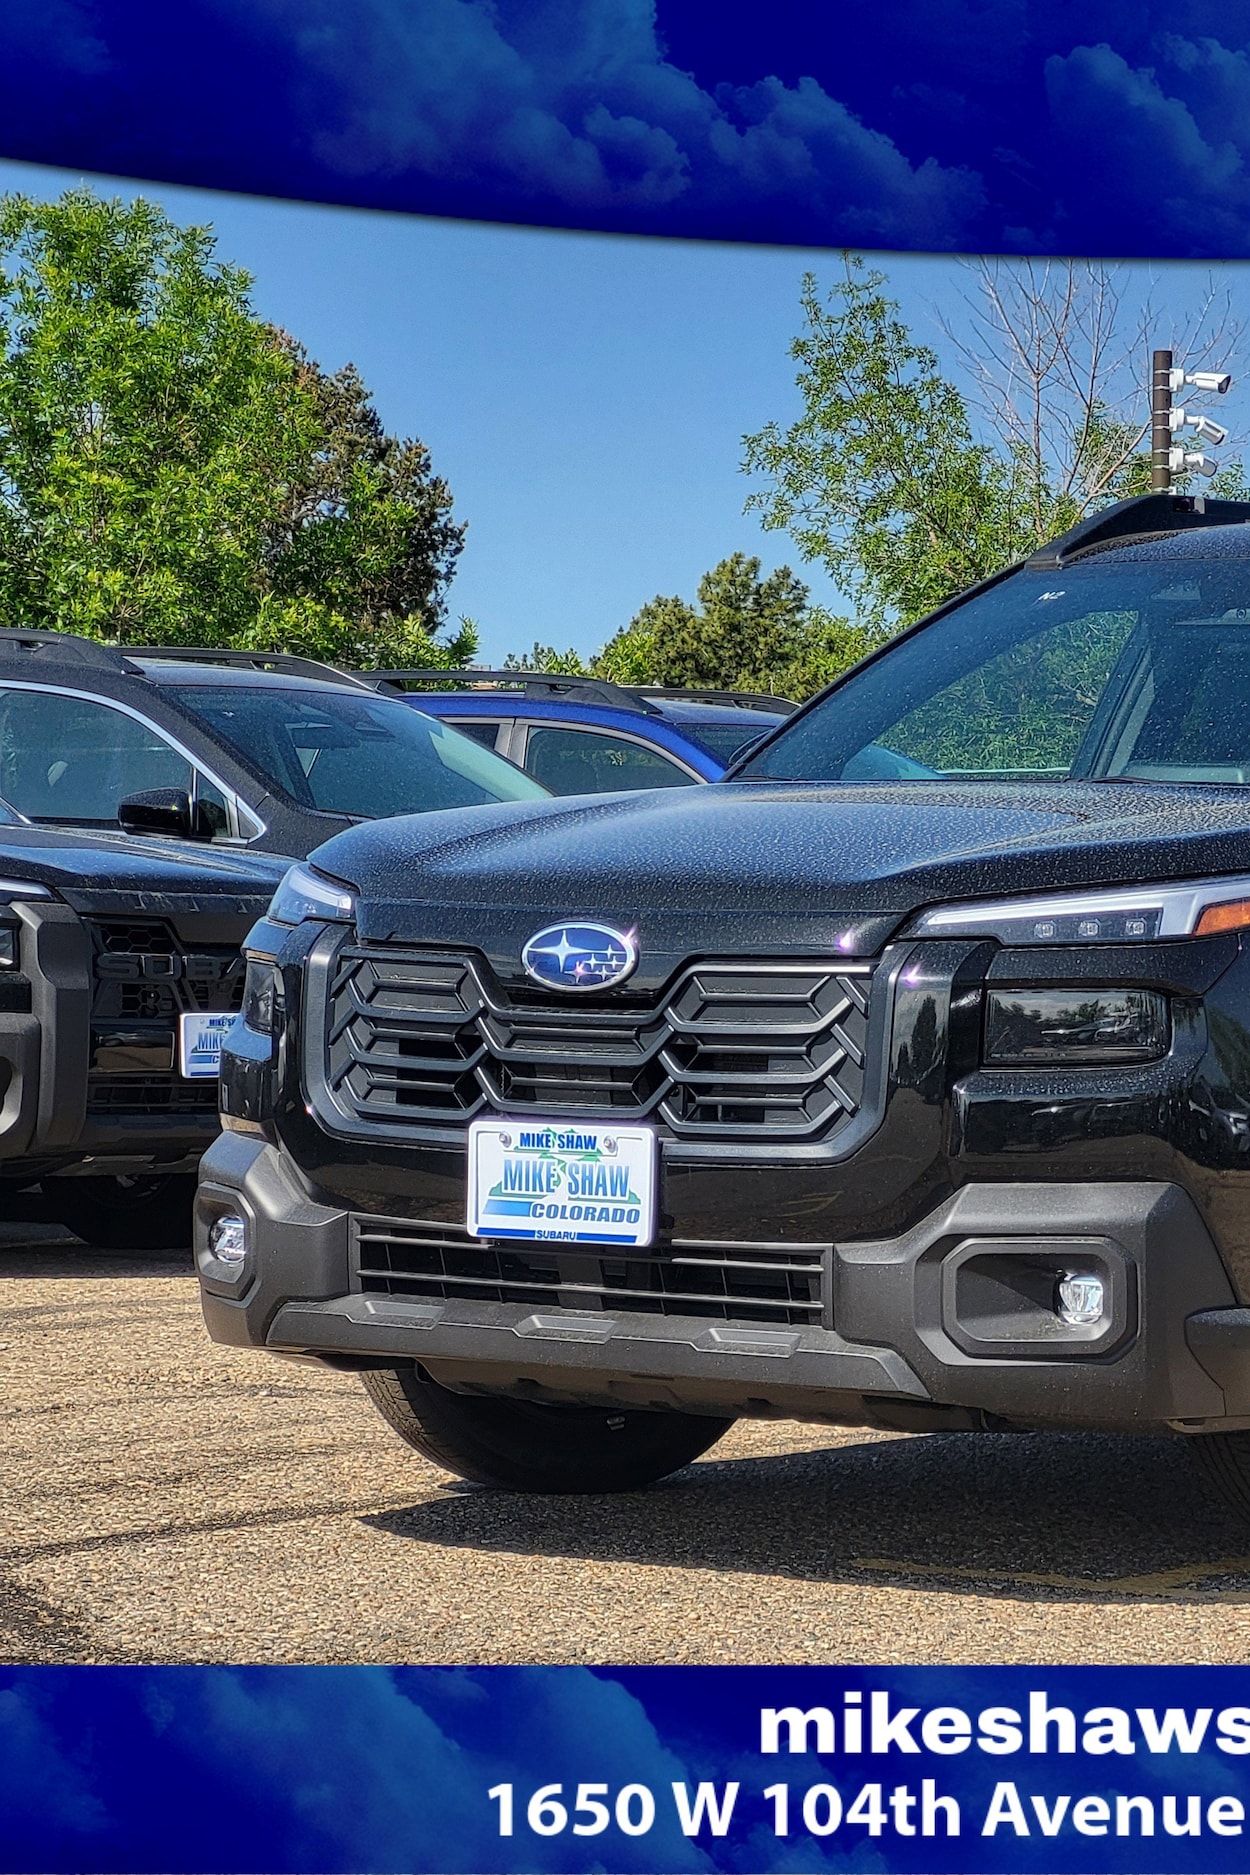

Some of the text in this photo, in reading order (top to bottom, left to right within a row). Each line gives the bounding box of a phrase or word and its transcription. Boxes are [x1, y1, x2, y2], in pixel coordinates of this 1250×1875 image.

[209, 1018, 226, 1027] MIKE
[519, 1132, 597, 1150] MIKE SHAW
[503, 1159, 630, 1197] MIKE SHAW
[531, 1203, 641, 1224] COLORADO
[535, 1230, 577, 1241] SUBARU
